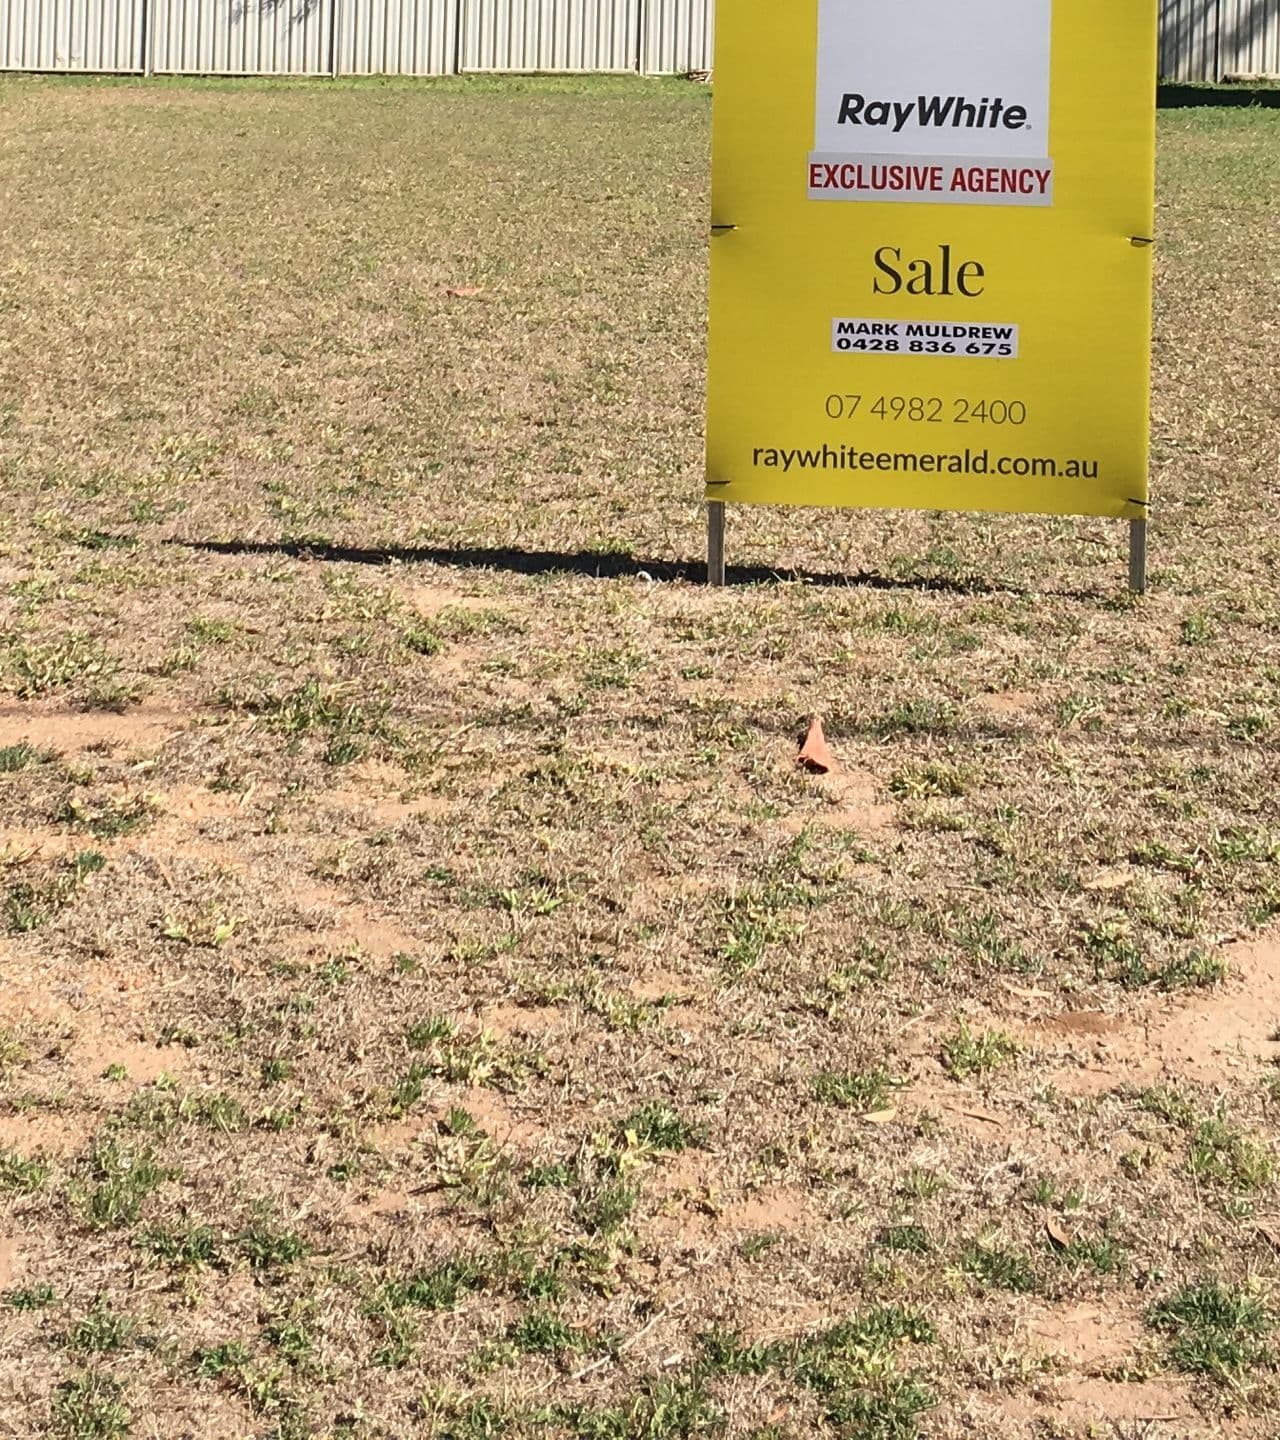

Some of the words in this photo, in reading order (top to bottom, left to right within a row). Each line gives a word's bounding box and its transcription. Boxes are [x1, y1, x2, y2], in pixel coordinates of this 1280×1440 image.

[808, 164, 943, 192] EXCLUSIVE
[950, 166, 1052, 194] AGENCY
[872, 244, 985, 298] Sale
[837, 322, 899, 338] MARK
[906, 324, 1014, 341] MULDREW
[836, 338, 899, 352] 0428
[908, 340, 956, 354] 836
[965, 342, 1012, 356] 675
[825, 394, 862, 420] 07
[870, 396, 944, 422] 4982
[952, 399, 1026, 425] 2400
[752, 444, 1098, 480] raywhiteemerald.com.au
